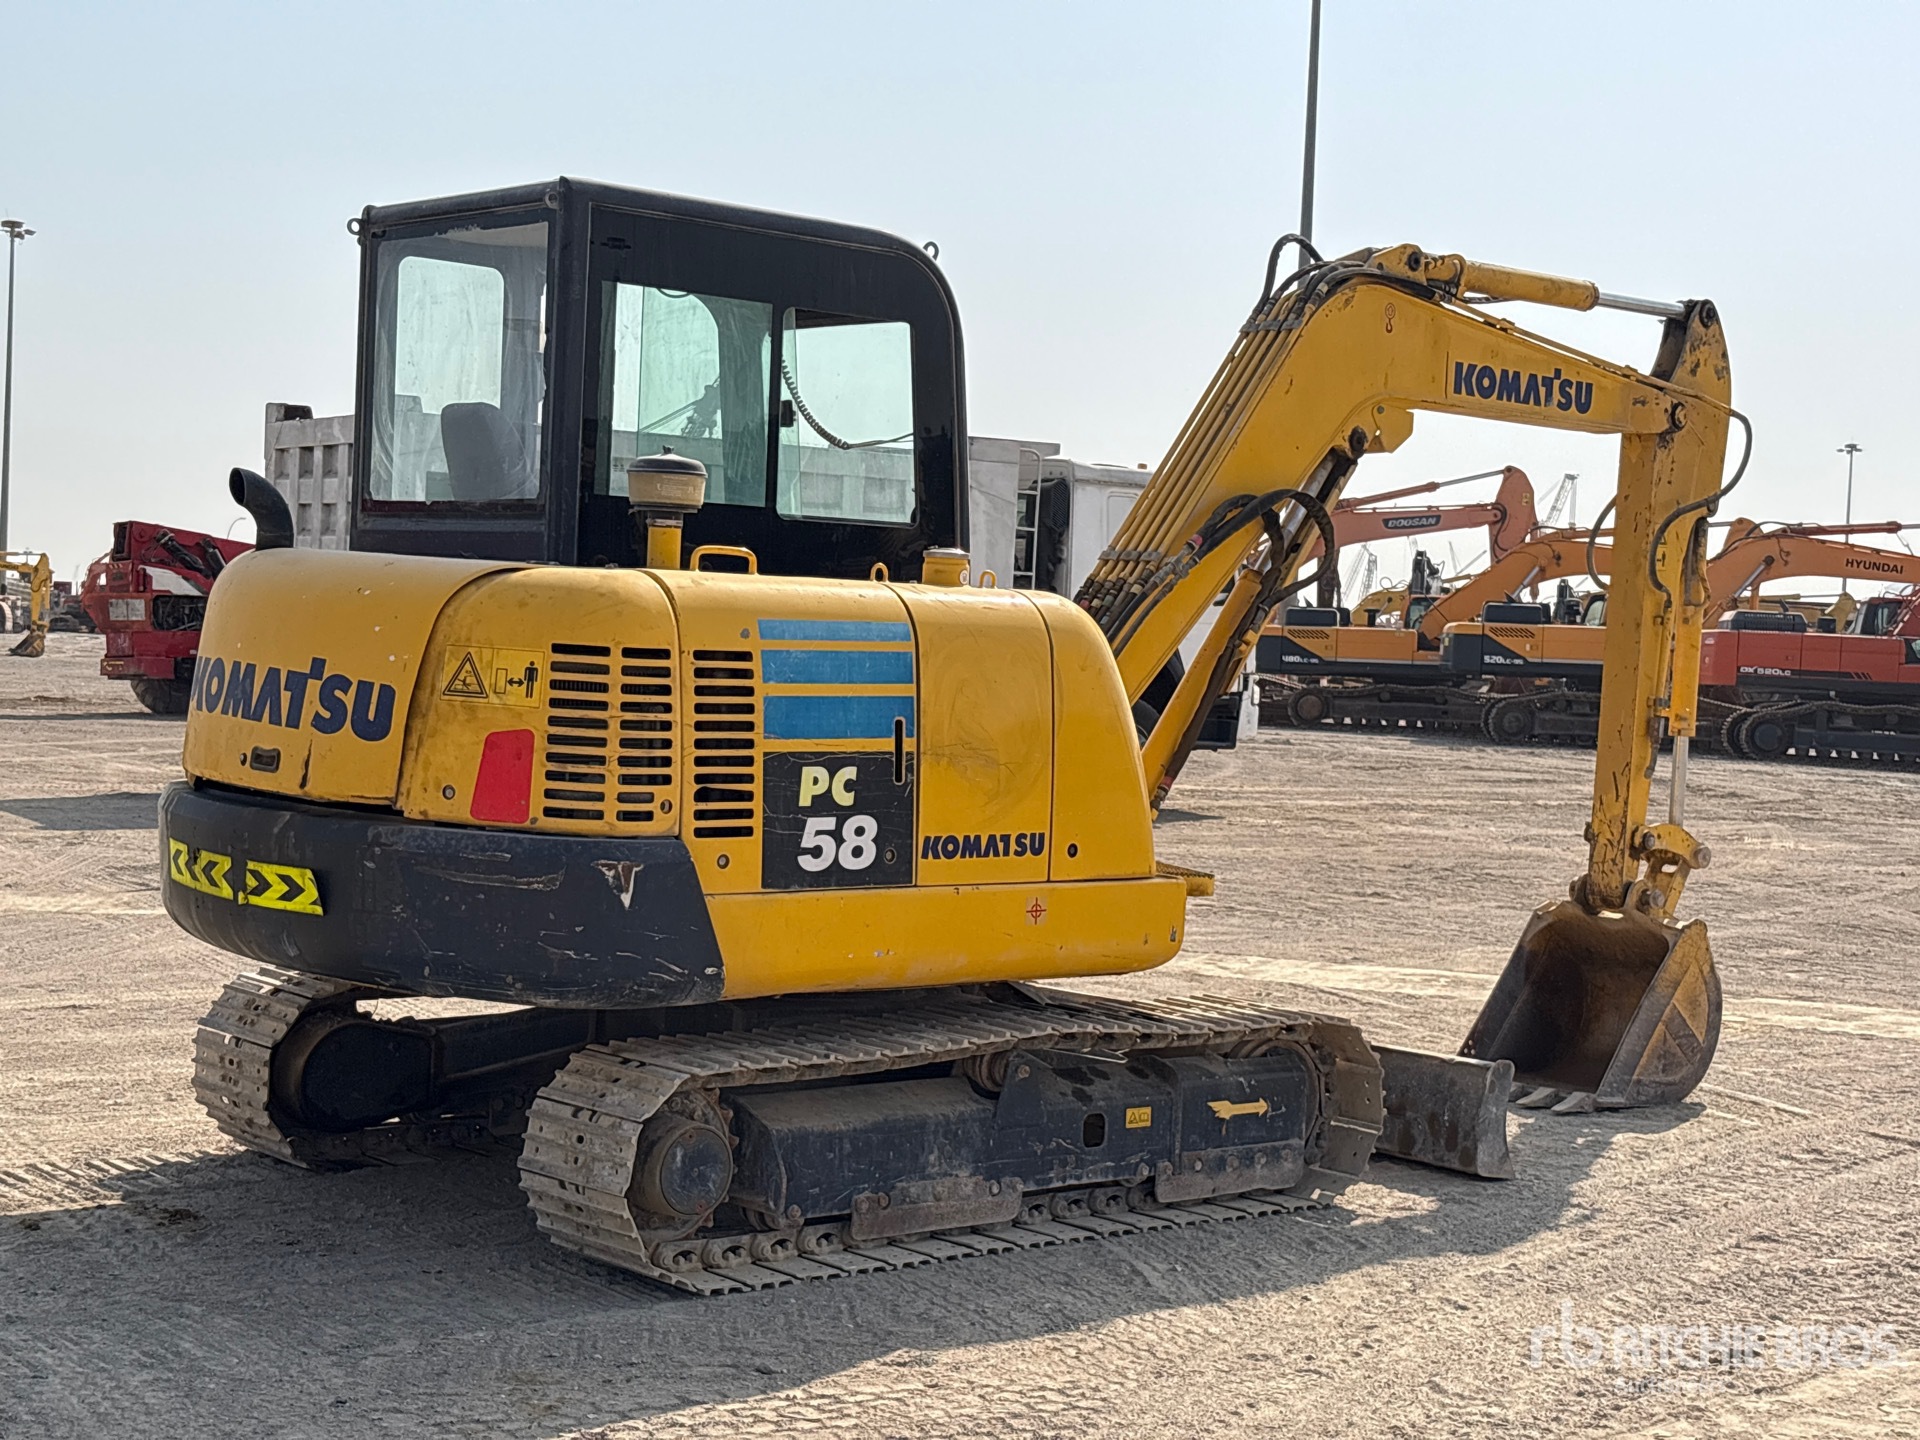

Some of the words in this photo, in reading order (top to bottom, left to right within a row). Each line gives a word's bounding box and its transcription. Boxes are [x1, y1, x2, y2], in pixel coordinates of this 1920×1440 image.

[1453, 361, 1594, 414] KOMATSU
[1388, 516, 1437, 528] DOOSAN
[1845, 557, 1904, 575] HYUNDAI
[190, 655, 397, 742] KOMATSU
[798, 765, 858, 808] PC
[796, 814, 878, 873] 58
[920, 831, 1046, 861] KOMATSU
